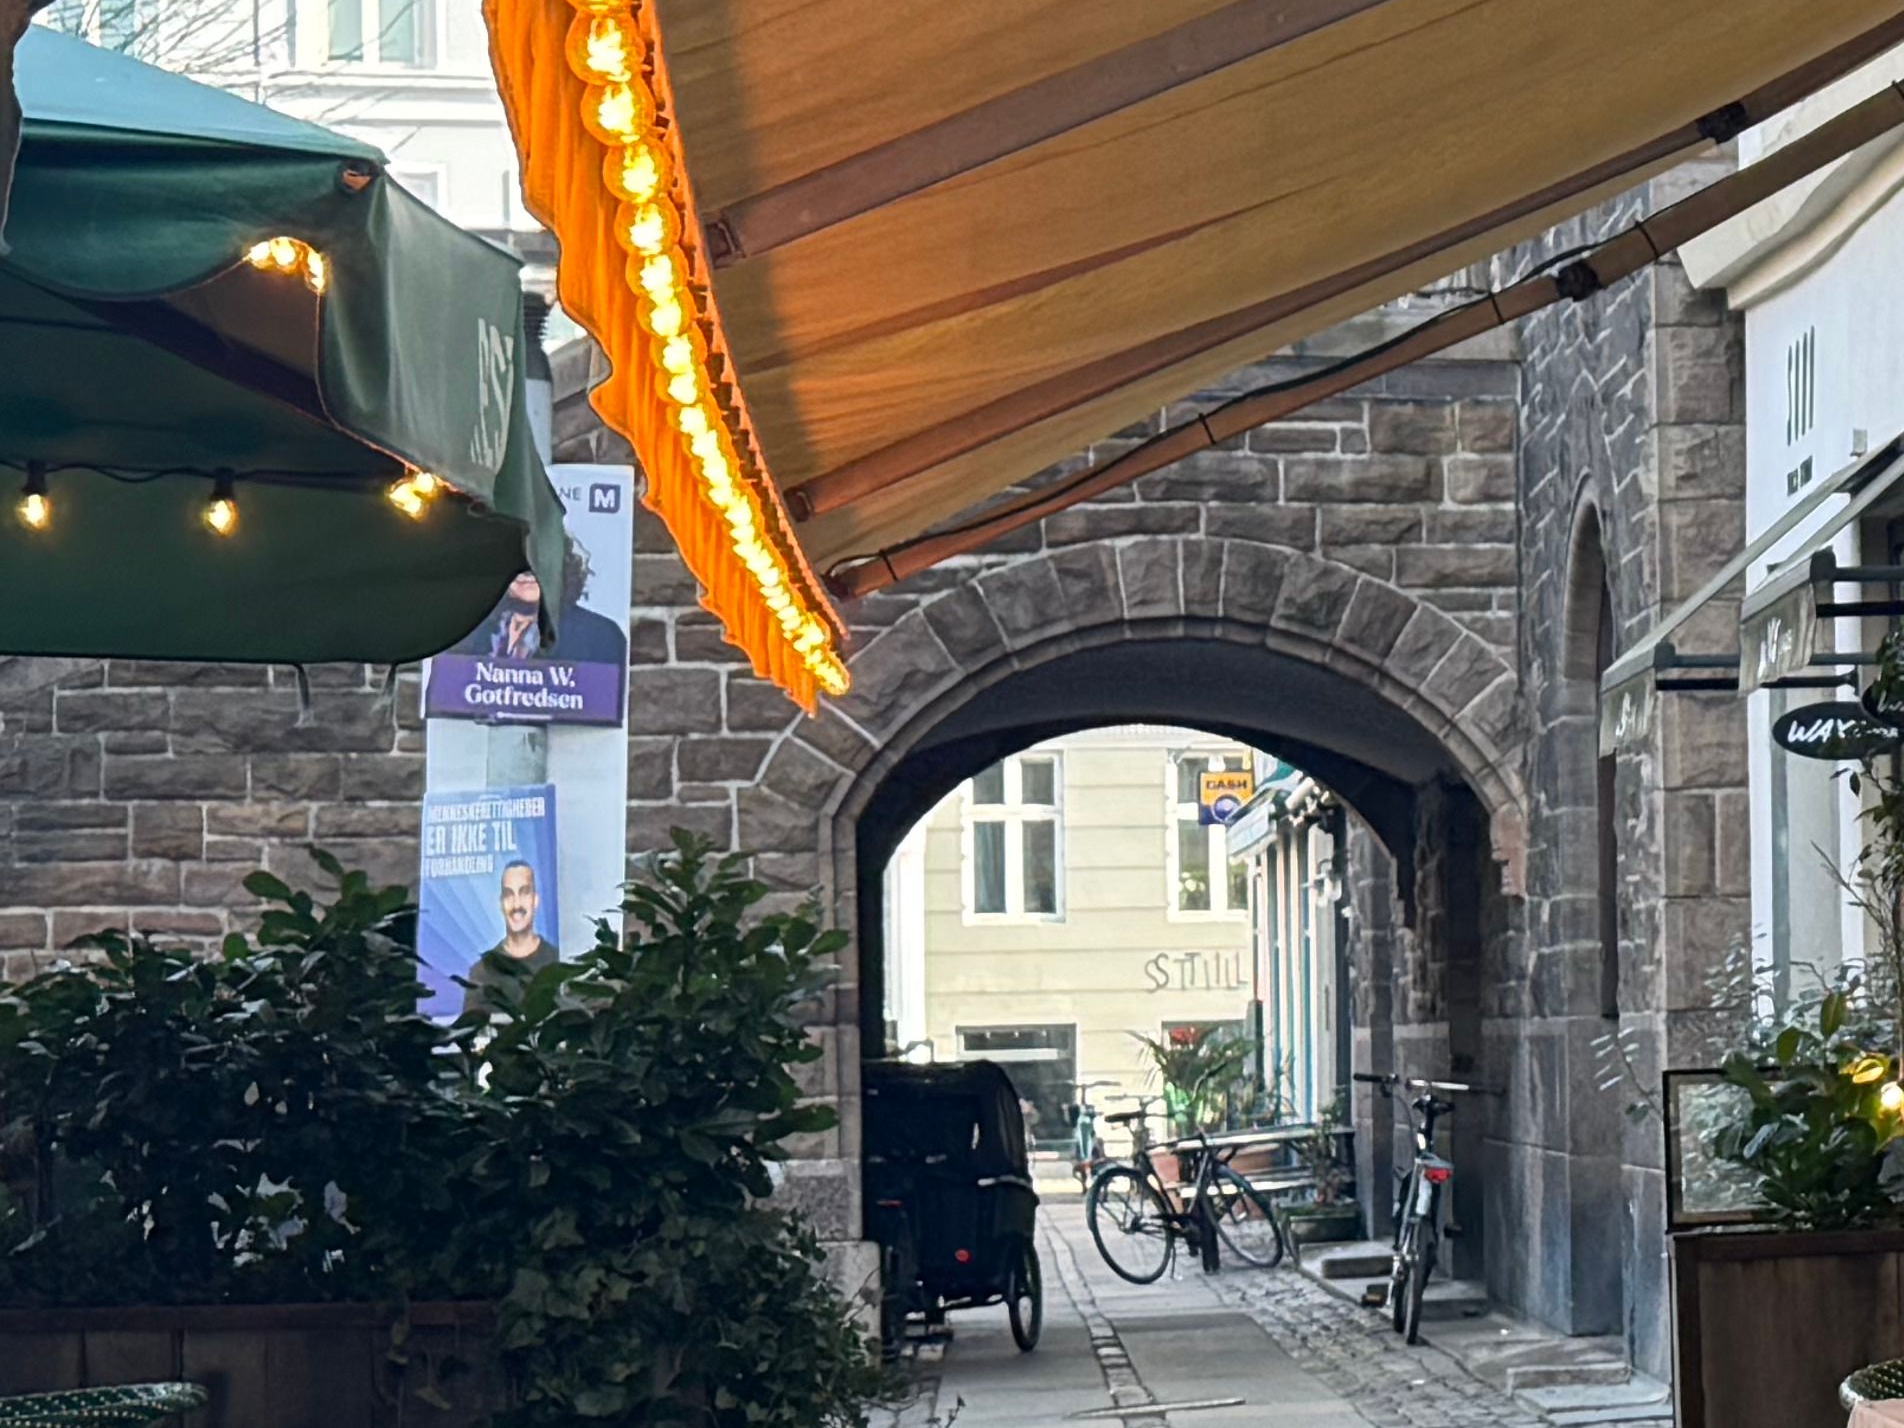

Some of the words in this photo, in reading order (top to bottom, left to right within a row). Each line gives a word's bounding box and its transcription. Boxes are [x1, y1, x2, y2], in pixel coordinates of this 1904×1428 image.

[559, 486, 582, 501] NE
[593, 487, 617, 510] M
[476, 662, 544, 685] Nanna
[549, 666, 576, 688] W.
[464, 683, 584, 710] Gotfredsen
[1205, 779, 1248, 790] CASH
[451, 822, 487, 854] IKKE
[491, 820, 517, 851] TIL
